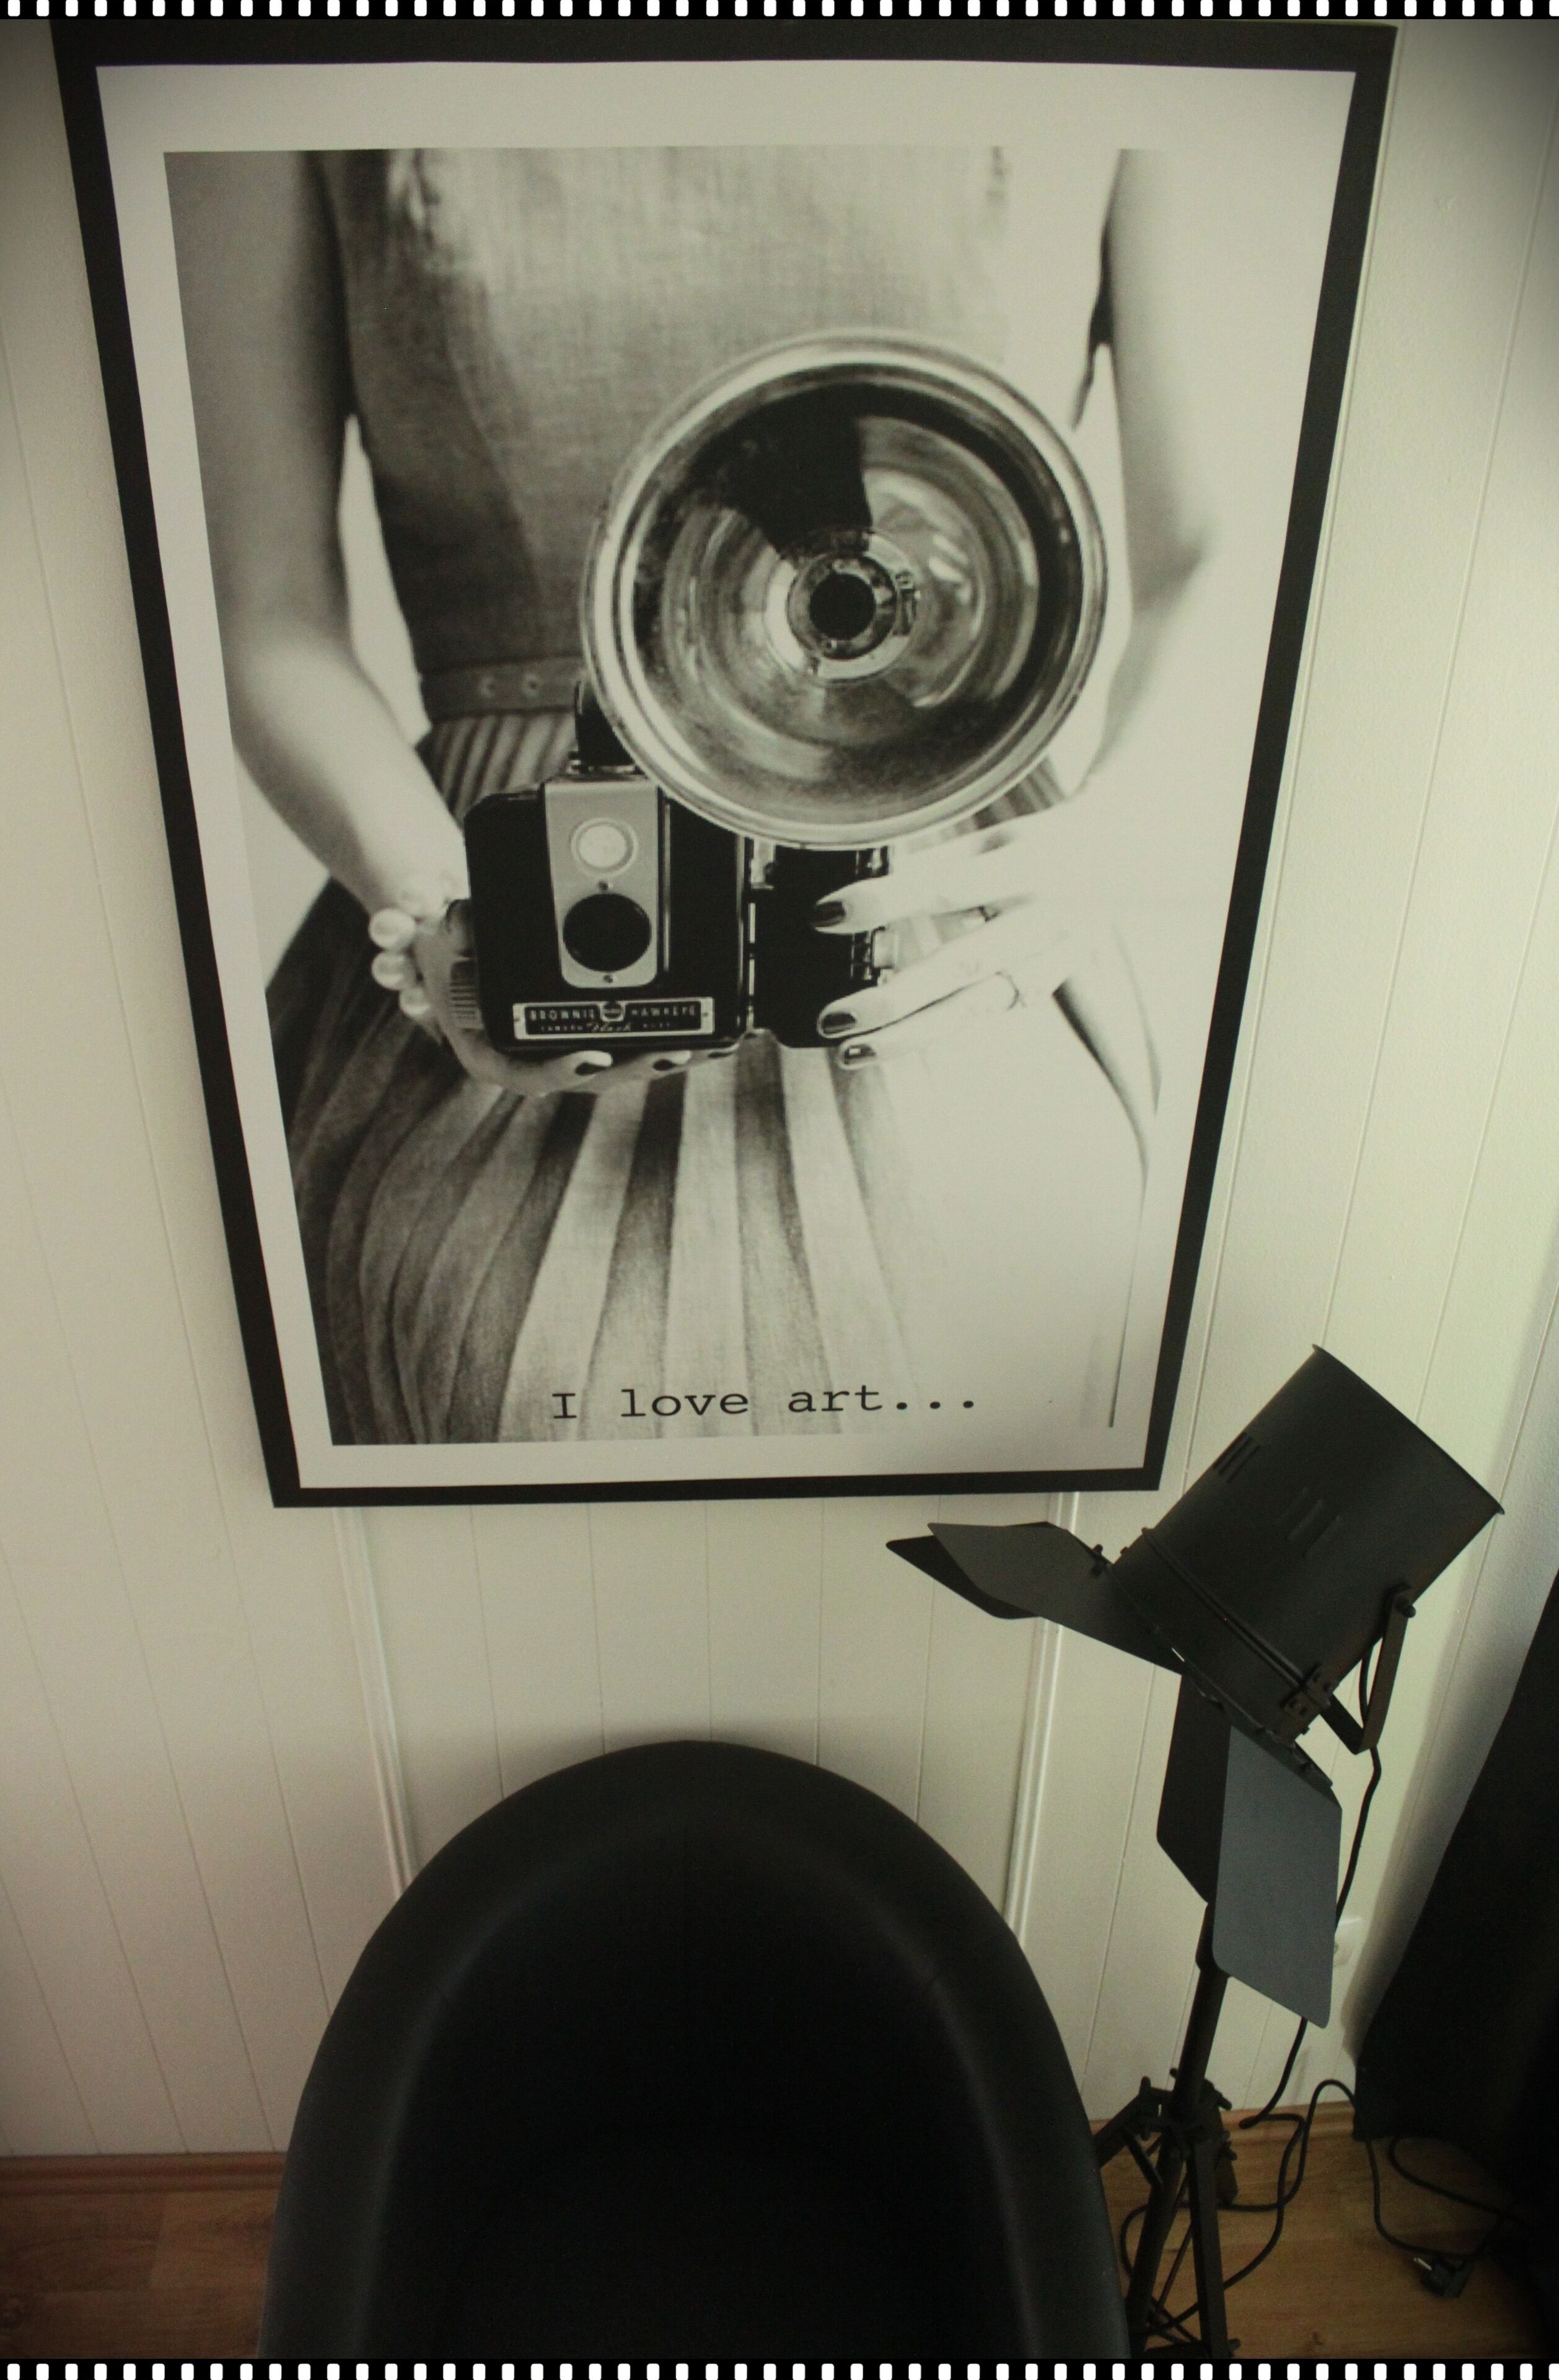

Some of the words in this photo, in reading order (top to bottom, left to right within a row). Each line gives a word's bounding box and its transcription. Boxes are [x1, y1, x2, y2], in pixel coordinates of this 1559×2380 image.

[551, 1392, 577, 1419] I
[620, 1388, 749, 1418] love
[788, 1385, 975, 1413] art...
